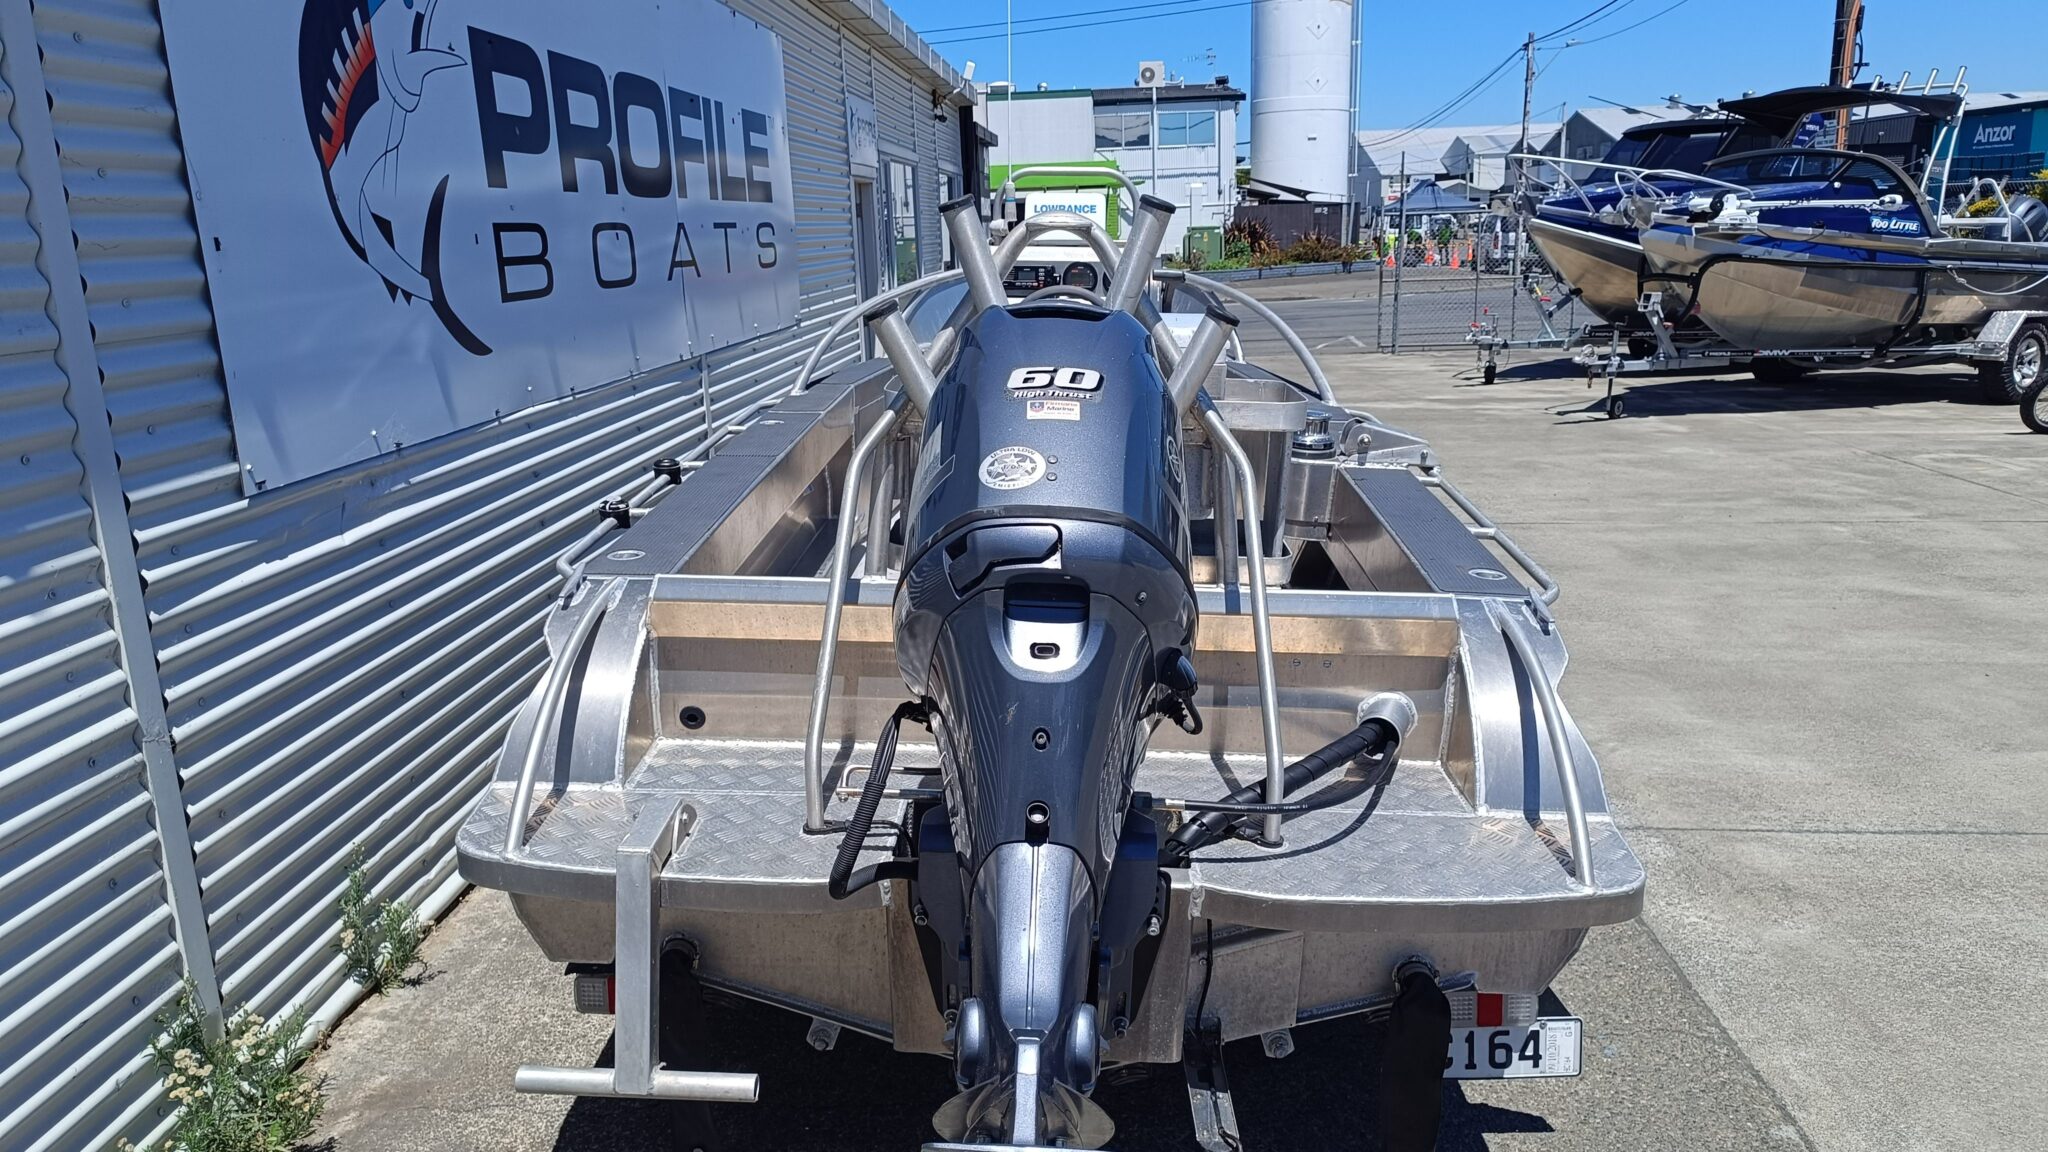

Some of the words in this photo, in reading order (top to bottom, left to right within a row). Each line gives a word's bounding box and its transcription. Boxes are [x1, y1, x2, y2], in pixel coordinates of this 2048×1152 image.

[467, 25, 773, 203] PROFILE
[1973, 123, 2016, 143] Anzor
[1034, 204, 1097, 214] LOWRANCE
[492, 222, 778, 304] BOATS
[1007, 367, 1103, 391] 60
[1013, 389, 1046, 399] High
[1047, 389, 1093, 399] Thrust
[1018, 447, 1036, 456] LOW
